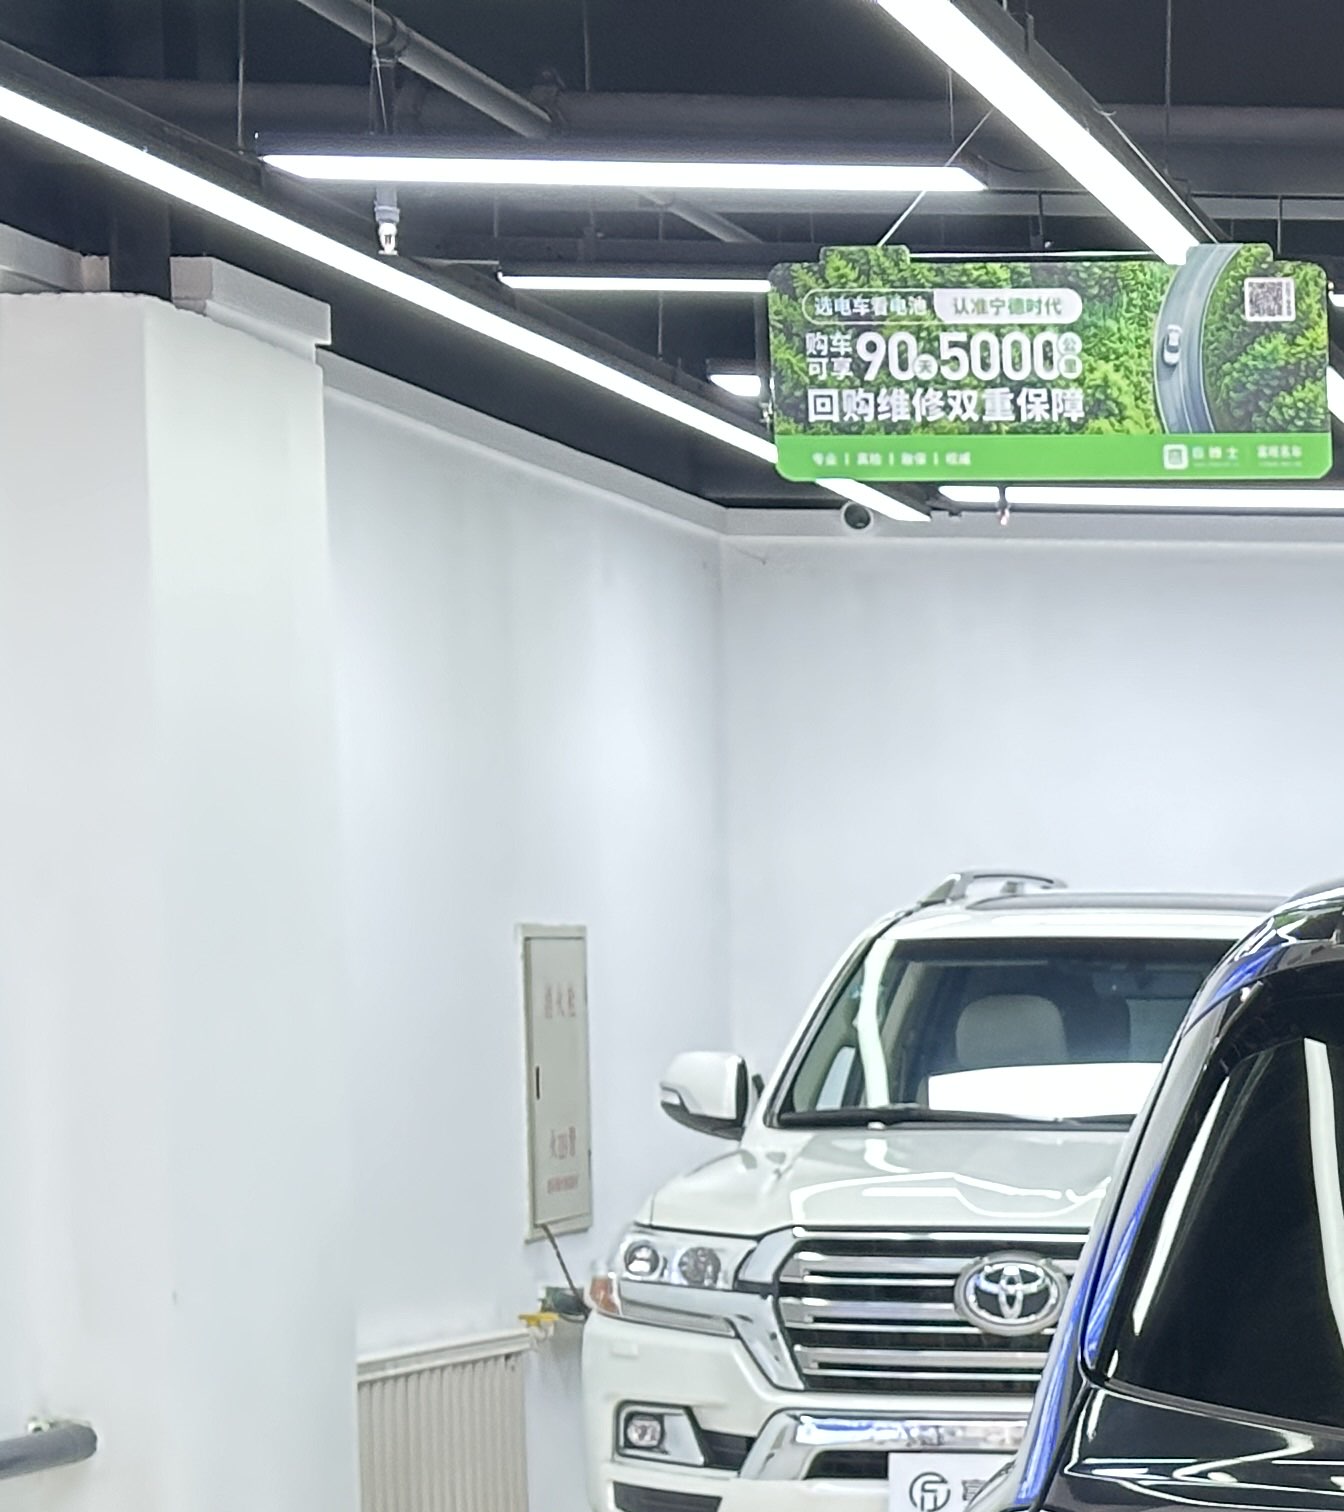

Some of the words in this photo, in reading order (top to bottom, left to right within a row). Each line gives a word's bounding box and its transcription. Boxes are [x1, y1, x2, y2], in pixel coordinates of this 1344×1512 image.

[814, 295, 927, 317] 选电车看电池
[952, 296, 1063, 316] 认准宁德时代
[805, 332, 852, 356] 购车
[807, 356, 853, 381] 可享
[807, 387, 1086, 423] 回购维修双重保障
